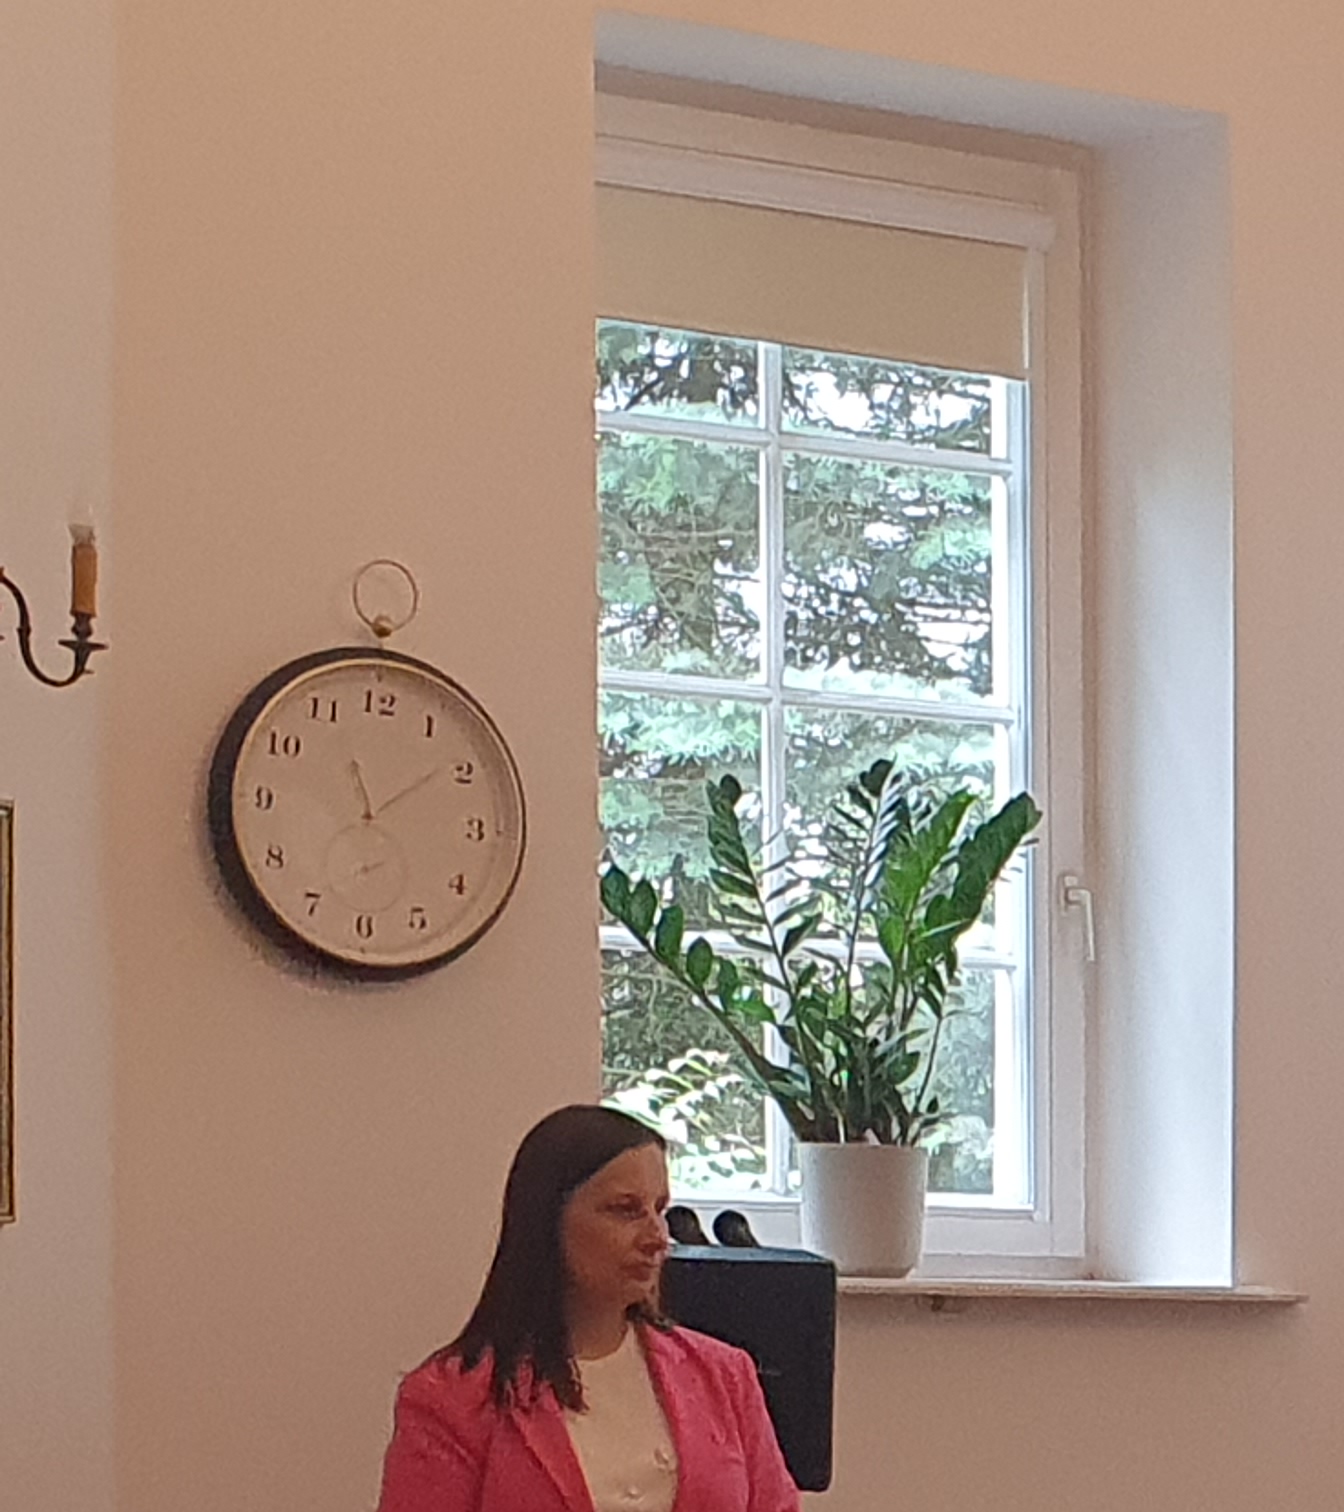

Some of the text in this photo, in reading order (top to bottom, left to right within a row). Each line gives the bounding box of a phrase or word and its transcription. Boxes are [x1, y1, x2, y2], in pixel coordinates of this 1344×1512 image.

[306, 696, 337, 723] 11
[364, 689, 397, 717] 12
[425, 714, 434, 738] 1
[266, 731, 301, 757] 10
[454, 761, 474, 785] 2
[255, 786, 274, 810] 9
[466, 818, 485, 842] 3
[265, 845, 284, 869] 8
[448, 873, 466, 896] 4
[304, 891, 321, 917] 7
[355, 915, 374, 939] 6
[408, 906, 427, 931] 5
